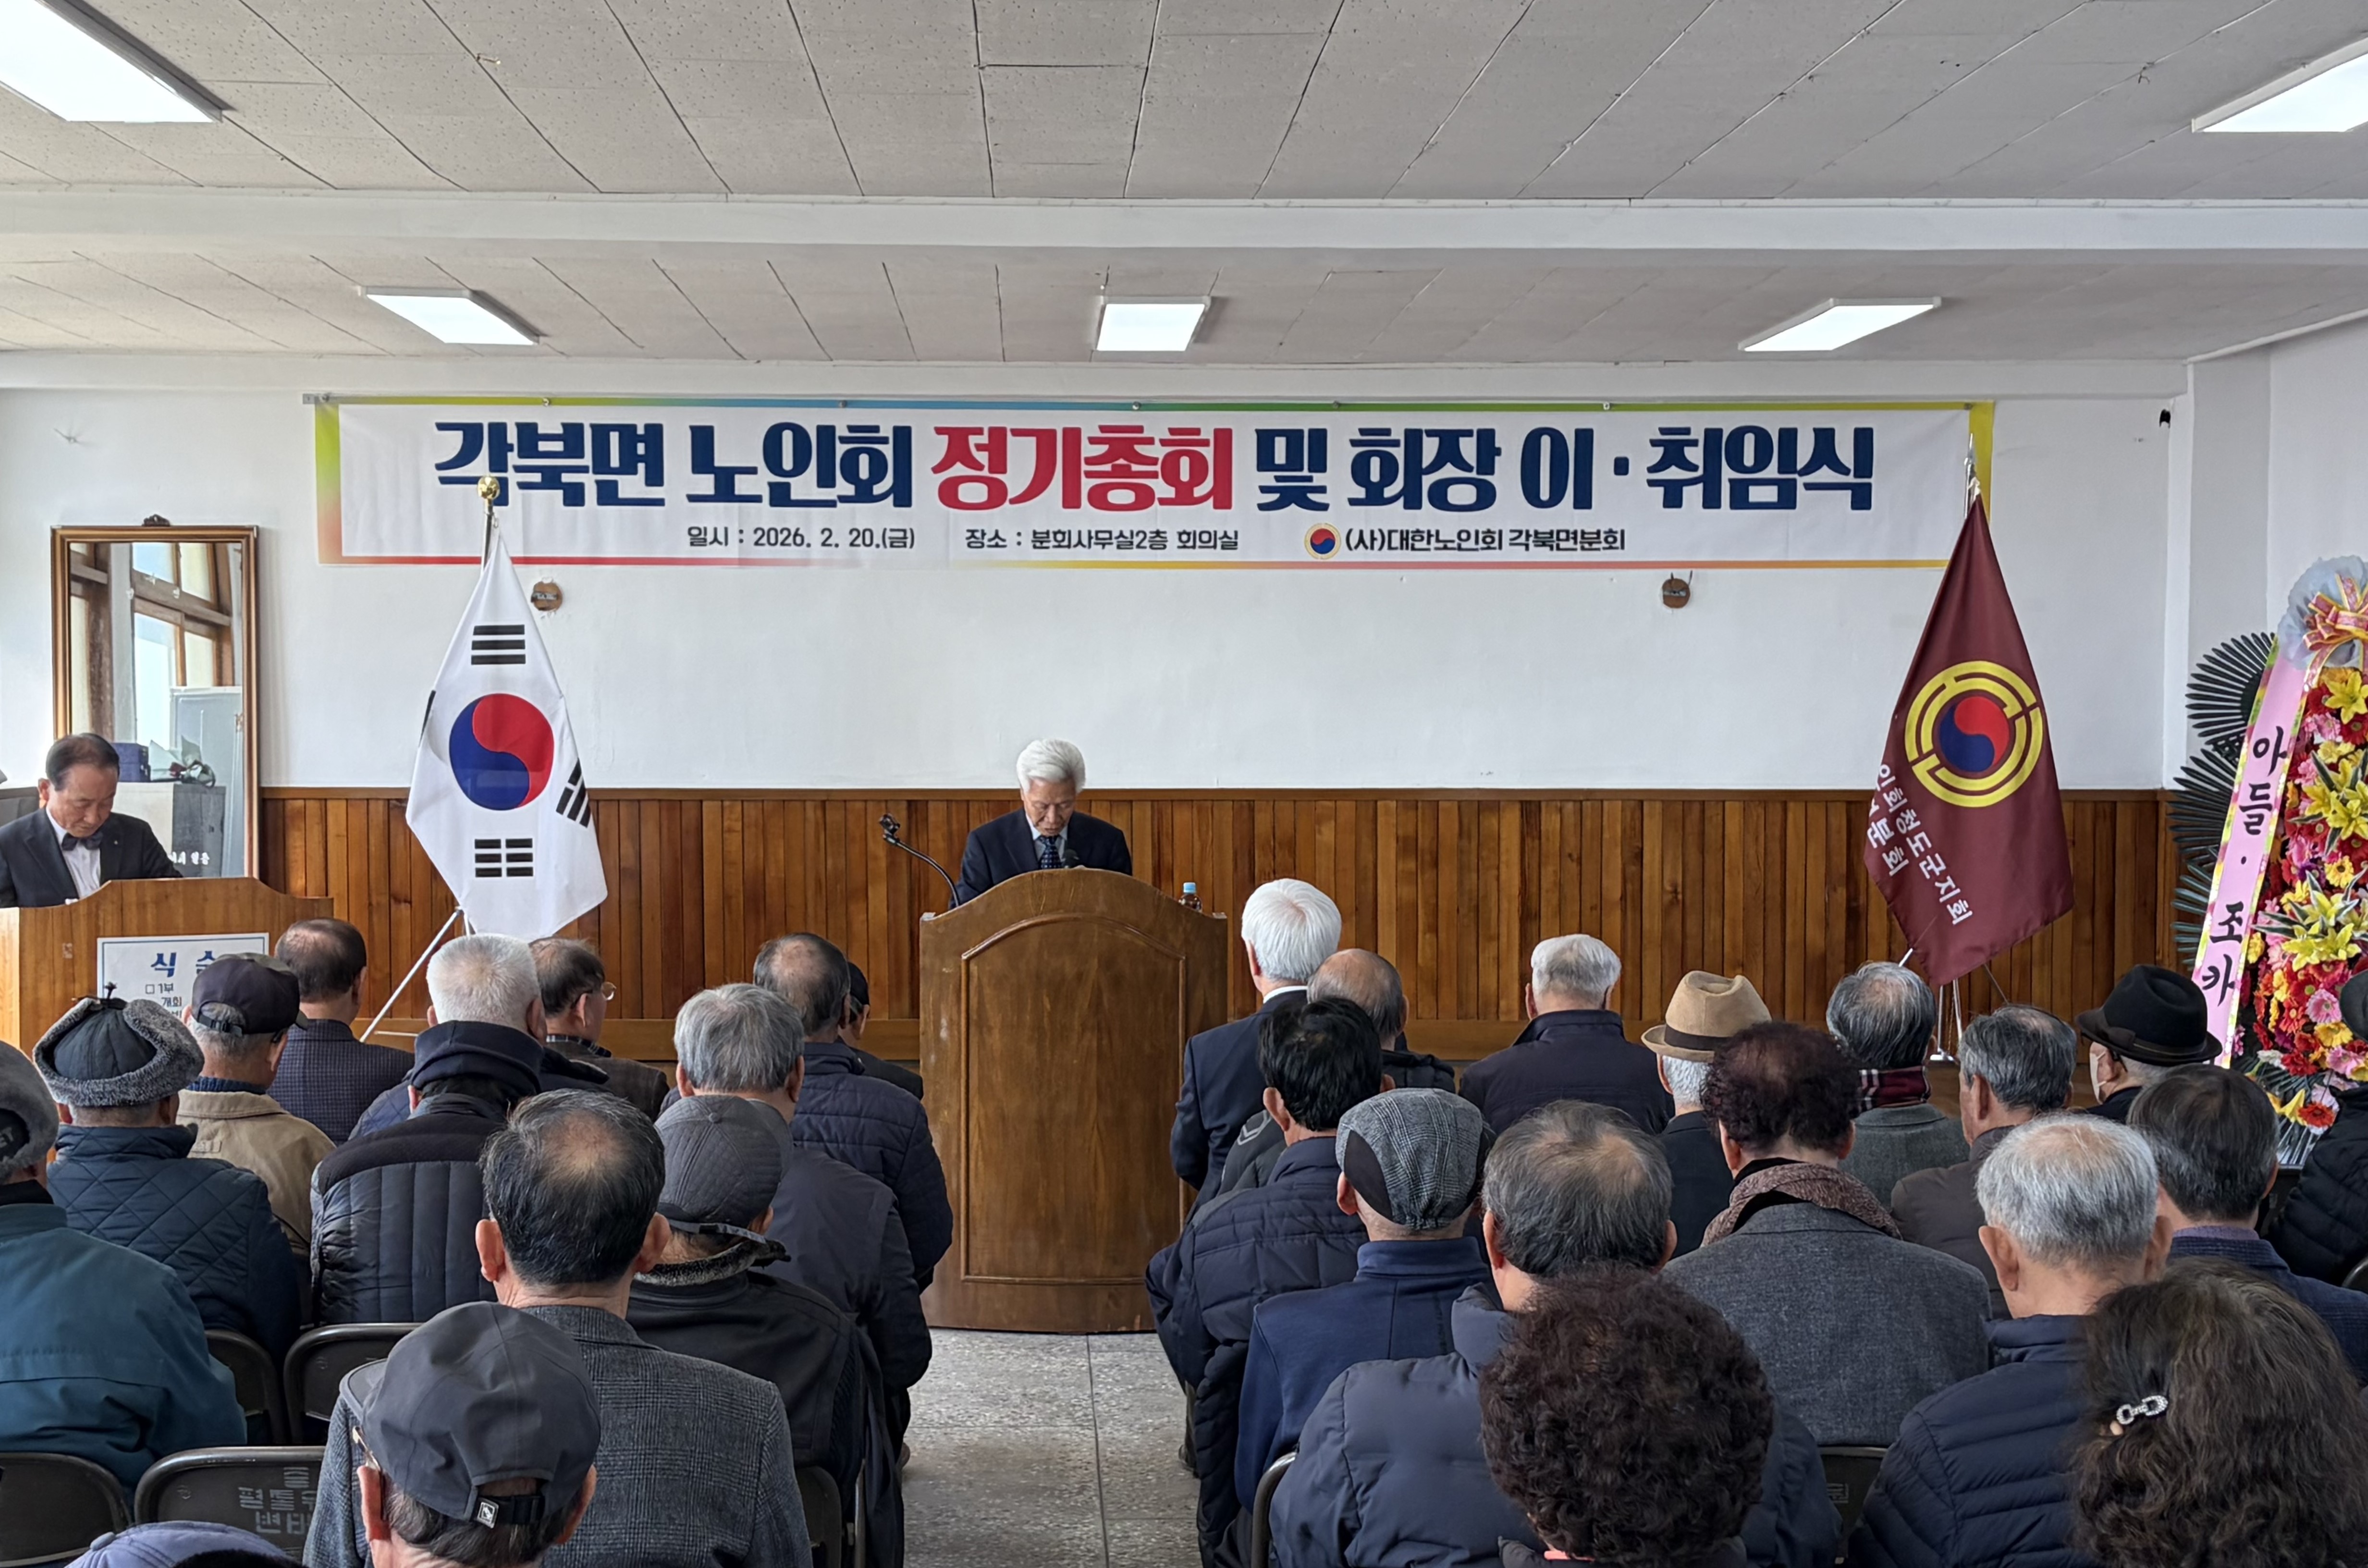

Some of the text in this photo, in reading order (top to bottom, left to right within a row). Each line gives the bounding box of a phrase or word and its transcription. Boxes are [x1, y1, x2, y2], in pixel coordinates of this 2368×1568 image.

[435, 422, 665, 507] 각북면
[686, 422, 912, 508] 노인회
[931, 425, 1232, 511] 정기총회
[1254, 428, 1330, 511] 및
[1348, 427, 1502, 512] 회장
[688, 527, 728, 547] 일시
[753, 527, 811, 548] 2026.
[821, 527, 839, 548] 2.
[848, 527, 915, 549] 20.(금)
[965, 529, 1007, 549] 장소
[1031, 529, 1168, 551] 분회사무실2층
[1177, 529, 1238, 551] 회의실
[1345, 528, 1503, 552] (사)대한노인회
[1509, 528, 1625, 551] 각북면분회
[2238, 725, 2288, 835] 아들
[1867, 797, 1910, 877] 분회
[150, 952, 176, 978] 식
[2202, 901, 2244, 1007] 조카
